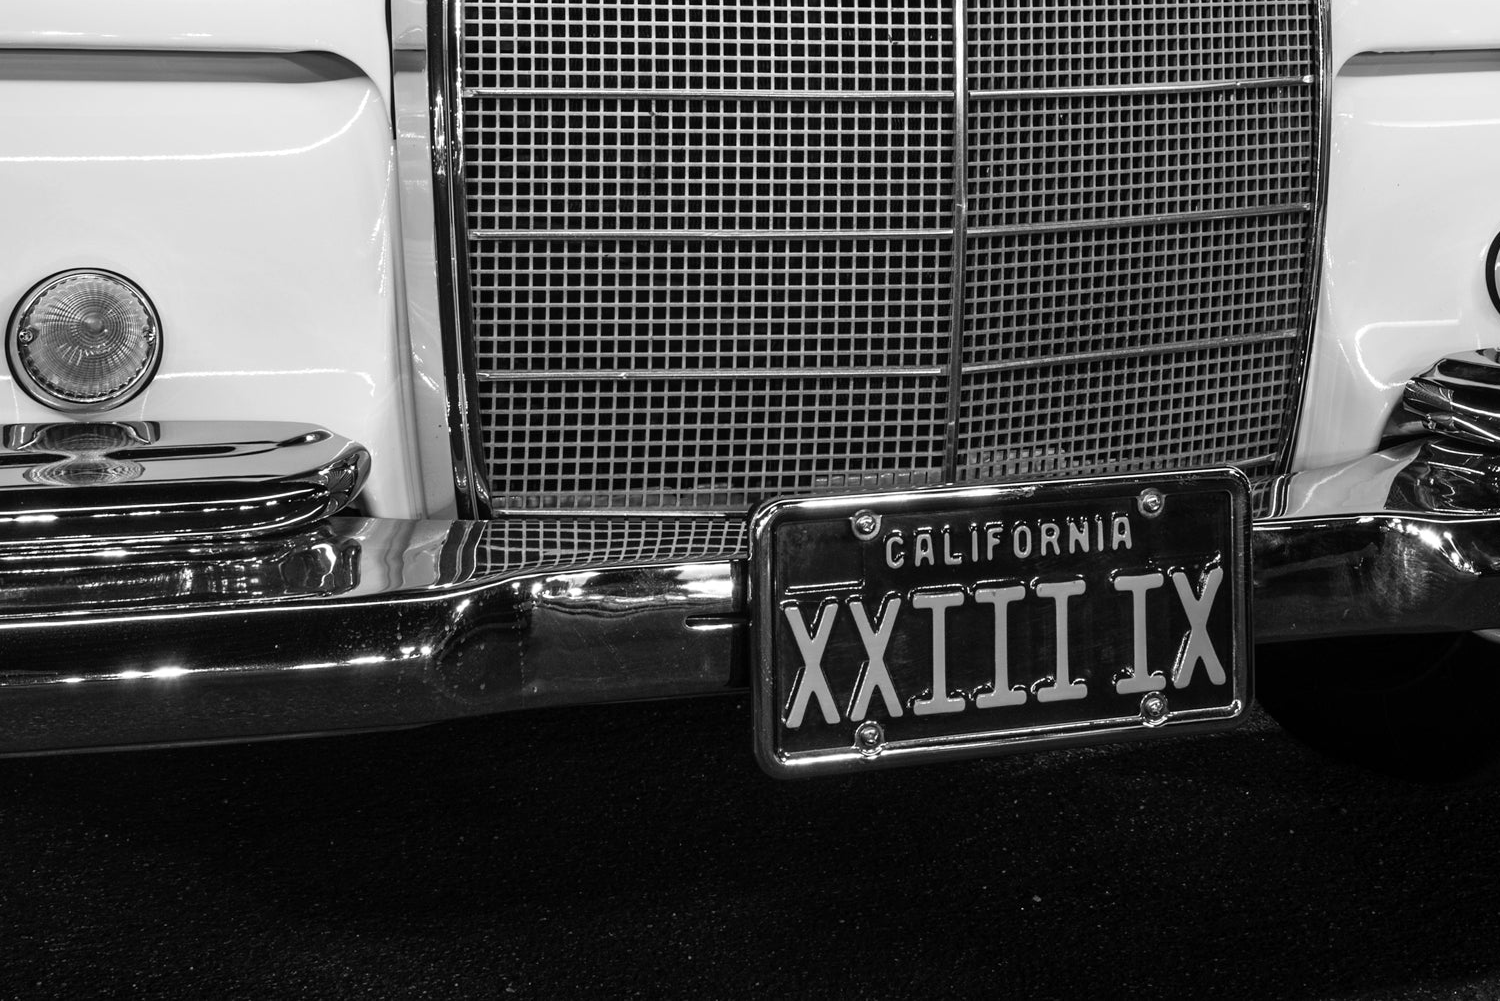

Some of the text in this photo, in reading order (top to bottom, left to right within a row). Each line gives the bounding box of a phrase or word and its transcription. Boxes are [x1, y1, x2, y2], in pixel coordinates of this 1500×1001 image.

[884, 513, 1133, 569] CALIFORNIA
[783, 564, 1227, 729] XXIII IX
